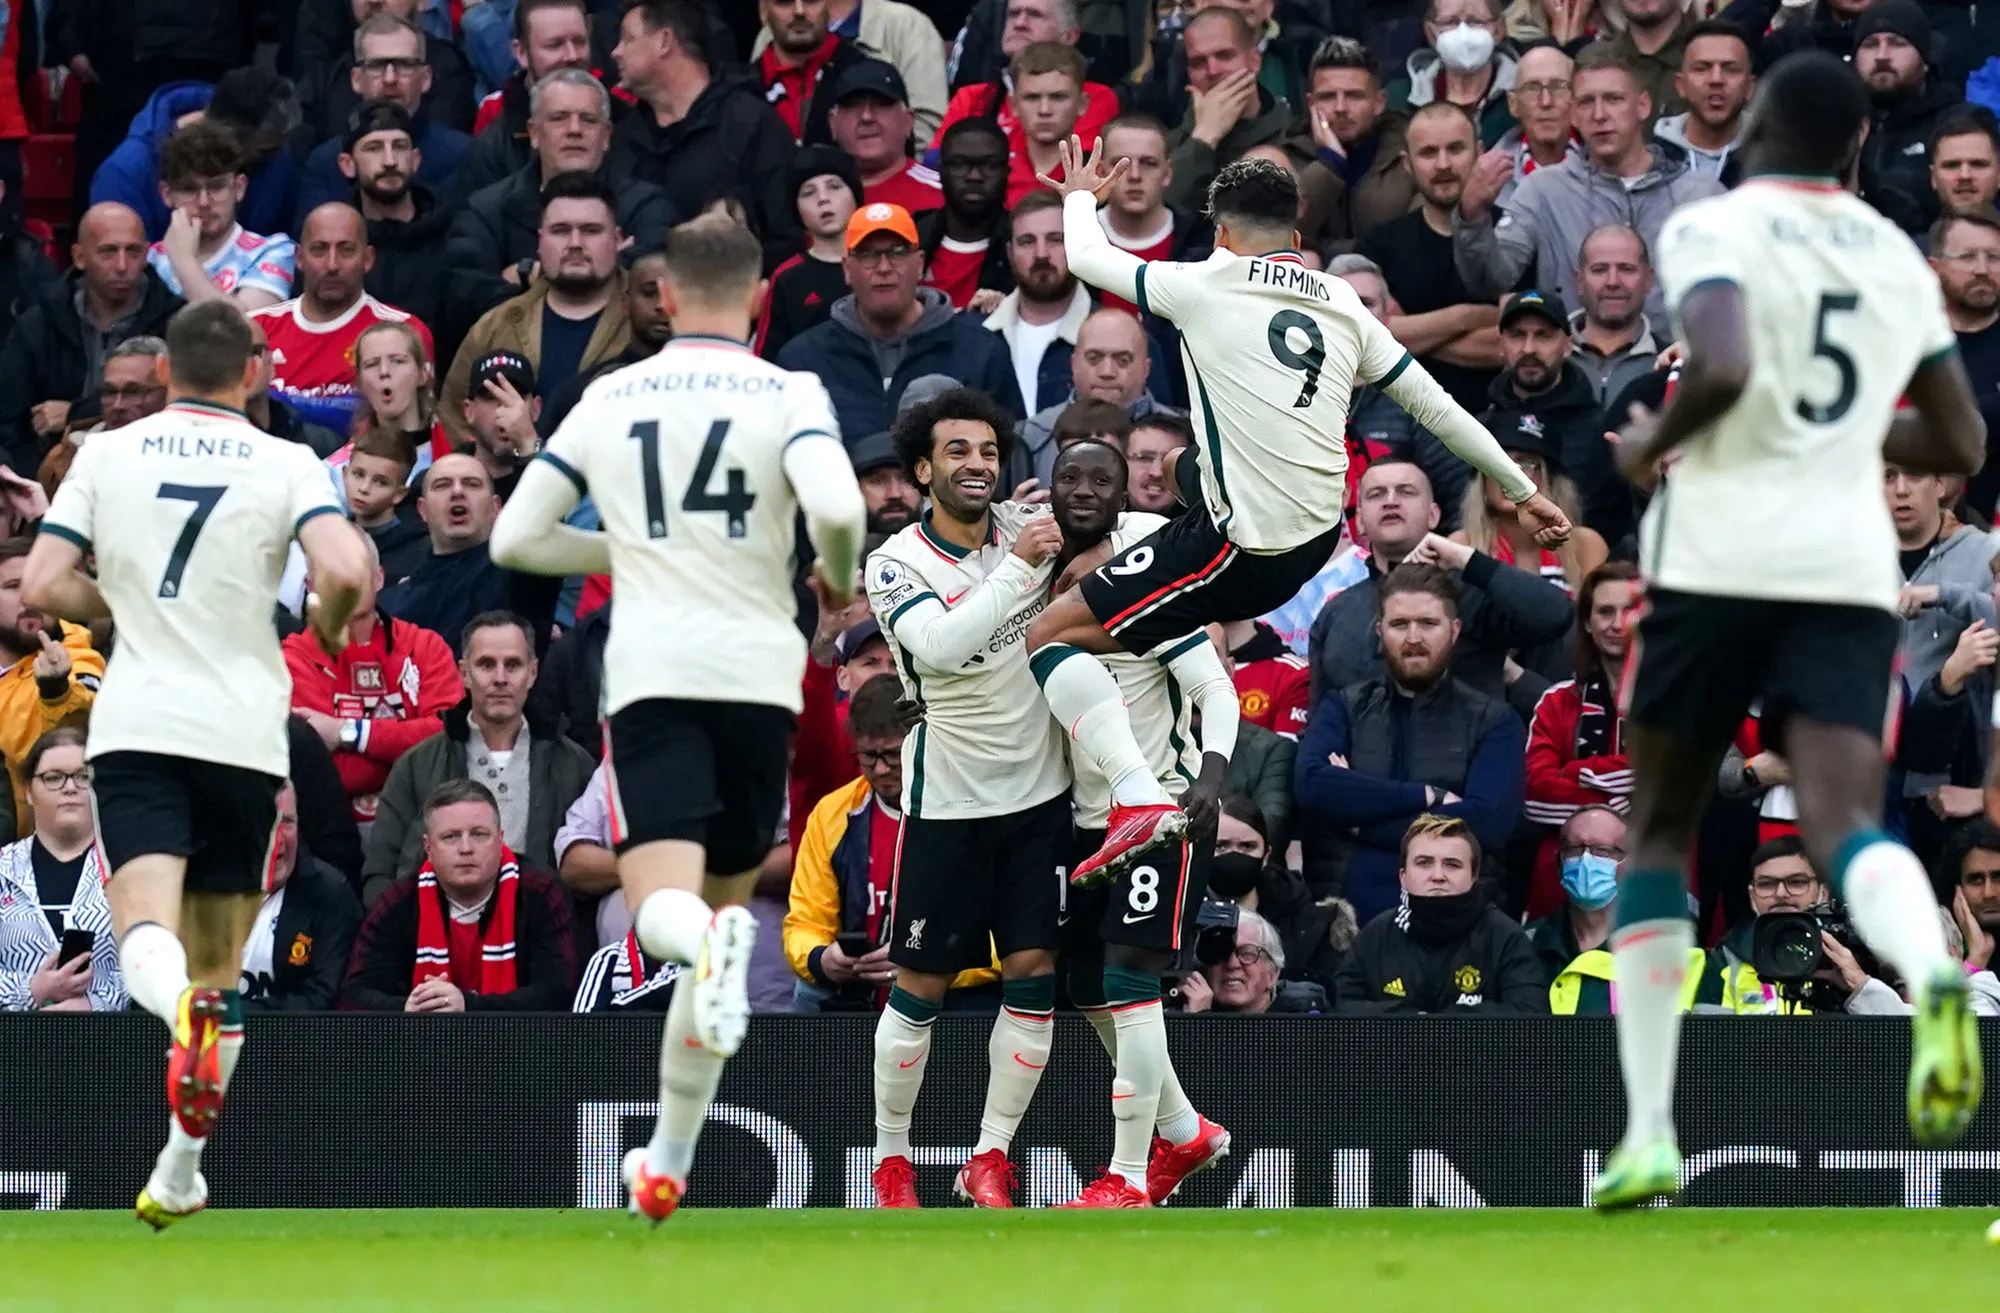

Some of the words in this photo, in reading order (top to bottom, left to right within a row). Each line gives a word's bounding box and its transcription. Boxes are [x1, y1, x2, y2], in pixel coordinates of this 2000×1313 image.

[1248, 259, 1330, 301] FIRMINO
[1267, 308, 1326, 408] 9
[1795, 290, 1862, 424] 5
[141, 434, 254, 461] MILNER
[627, 418, 758, 539] 14
[156, 481, 230, 599] 7
[1109, 545, 1155, 576] 9
[1128, 865, 1160, 912] 8
